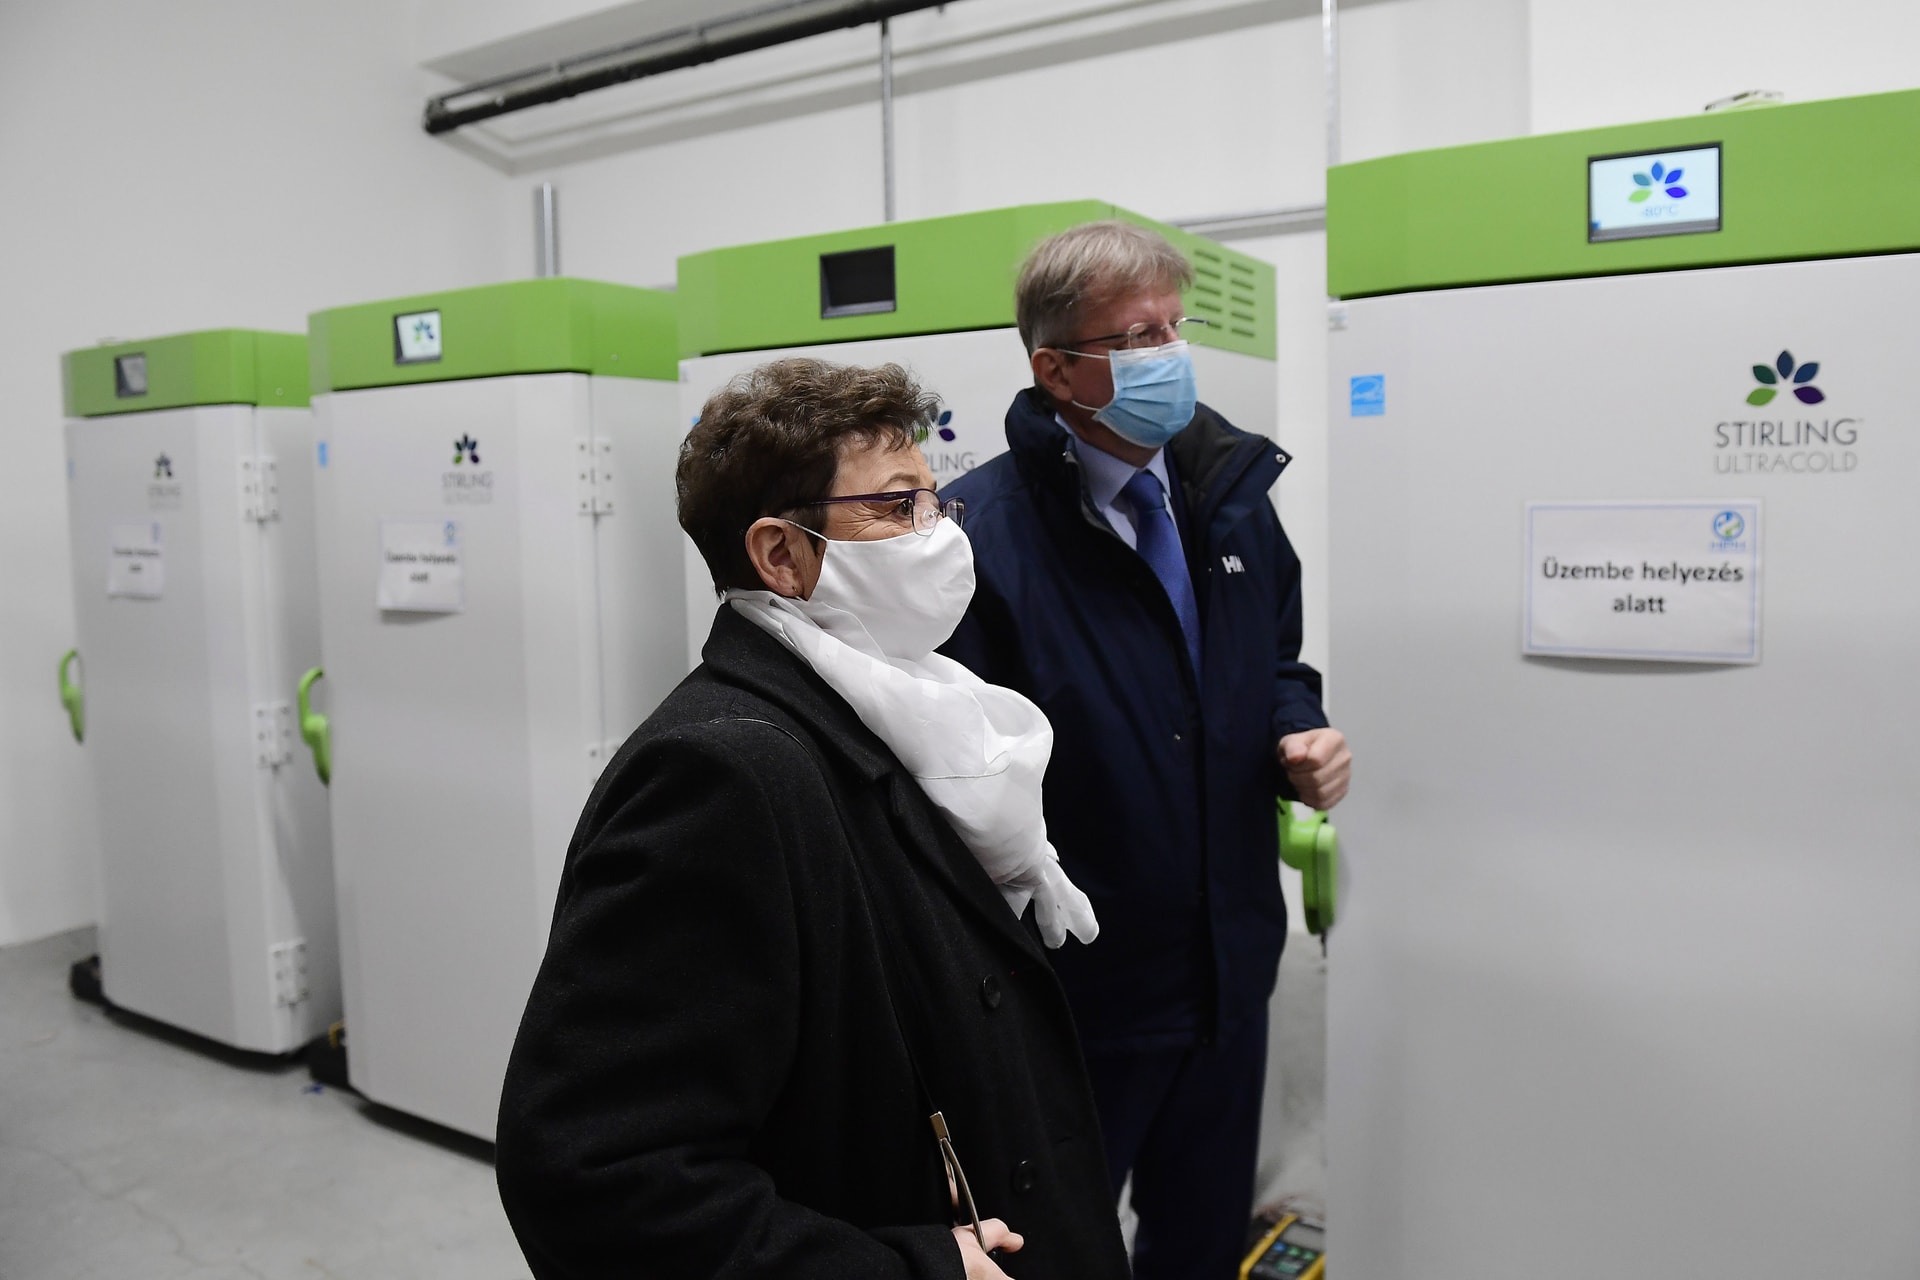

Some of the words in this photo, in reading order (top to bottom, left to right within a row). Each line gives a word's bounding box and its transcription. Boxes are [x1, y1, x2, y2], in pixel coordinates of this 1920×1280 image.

[1715, 418, 1858, 448] STIRLING
[1715, 451, 1858, 474] ULTRACOLD
[1543, 557, 1635, 581] Üzembe
[1642, 557, 1745, 585] helyezés
[1612, 594, 1667, 614] alatt
